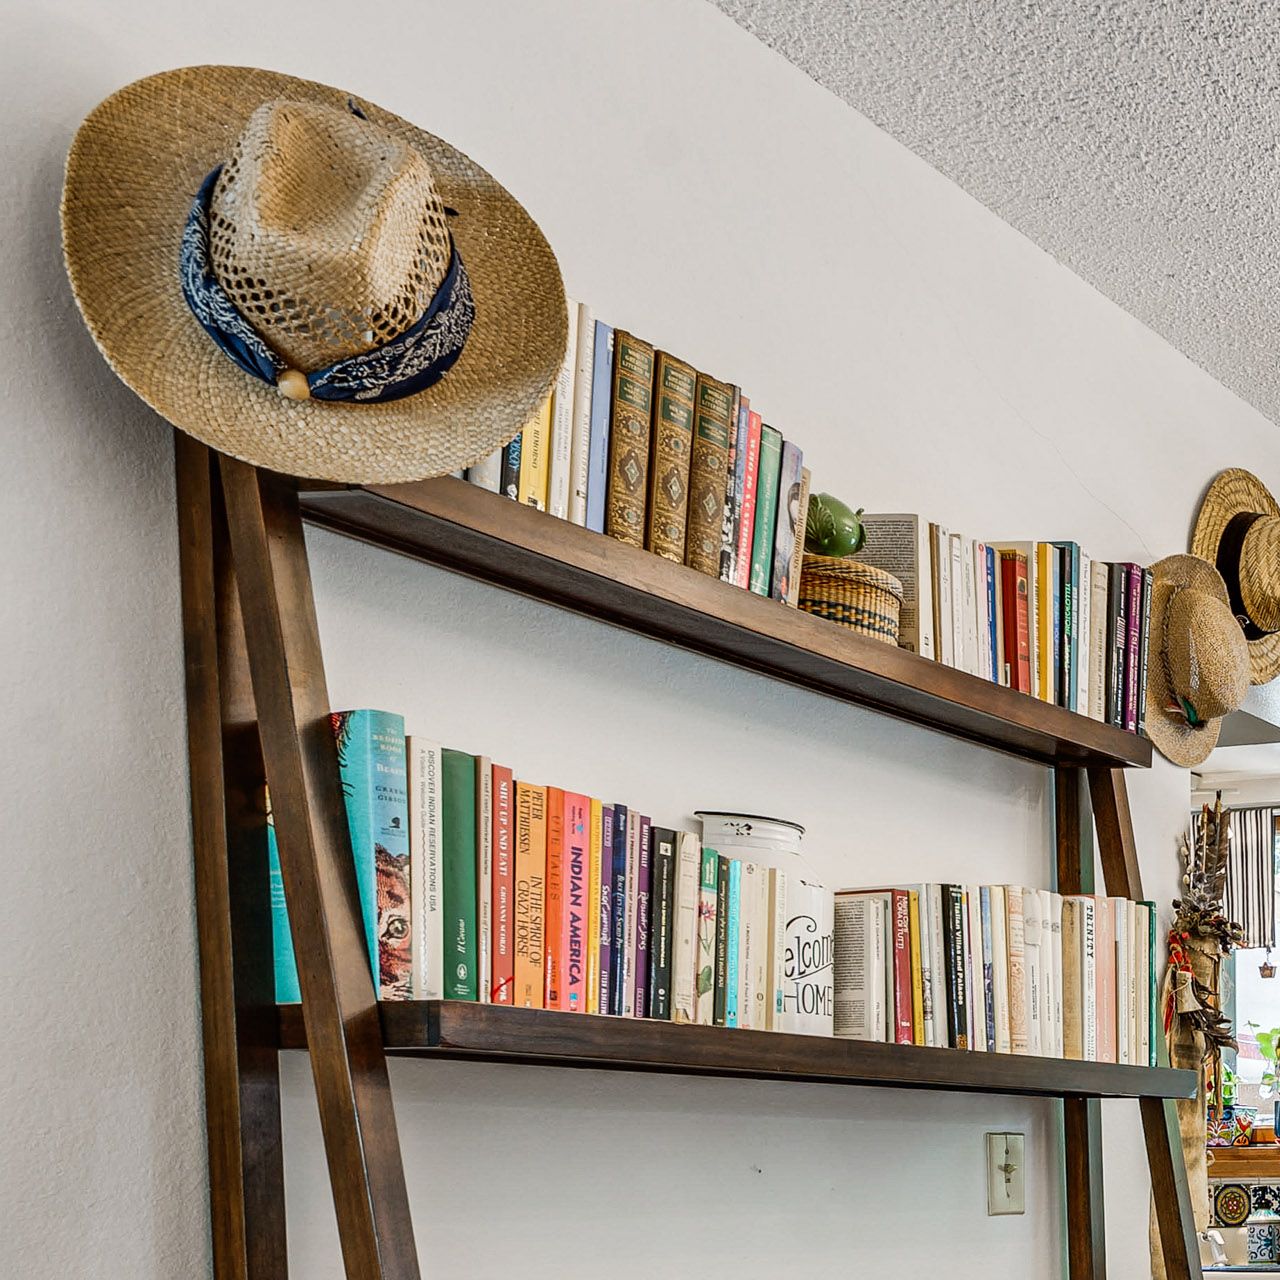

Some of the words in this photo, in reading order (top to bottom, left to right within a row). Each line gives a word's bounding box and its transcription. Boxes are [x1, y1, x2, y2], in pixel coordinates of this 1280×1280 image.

[427, 750, 436, 793] DISCOVER
[428, 795, 436, 825] INDIAN
[500, 781, 508, 810] SHUT
[532, 790, 543, 820] PETER
[500, 812, 507, 825] UP
[520, 788, 530, 855] MATTHIESSEN
[551, 815, 560, 845] UTE
[500, 829, 508, 851] AND
[428, 828, 437, 893] RESERVATIONS
[499, 853, 507, 877] EAT!
[550, 852, 560, 901] TALES
[570, 846, 583, 906] INDIAN
[518, 880, 529, 917] CRAZY
[530, 876, 542, 888] IN
[530, 890, 542, 914] THE
[517, 919, 528, 957] HORSE
[530, 915, 542, 949] SPIRIT
[1086, 905, 1094, 958] TRINITY
[529, 951, 541, 968] OF
[569, 912, 581, 986] AMERICA
[785, 918, 834, 980] elcom
[784, 982, 833, 1016] HOME
